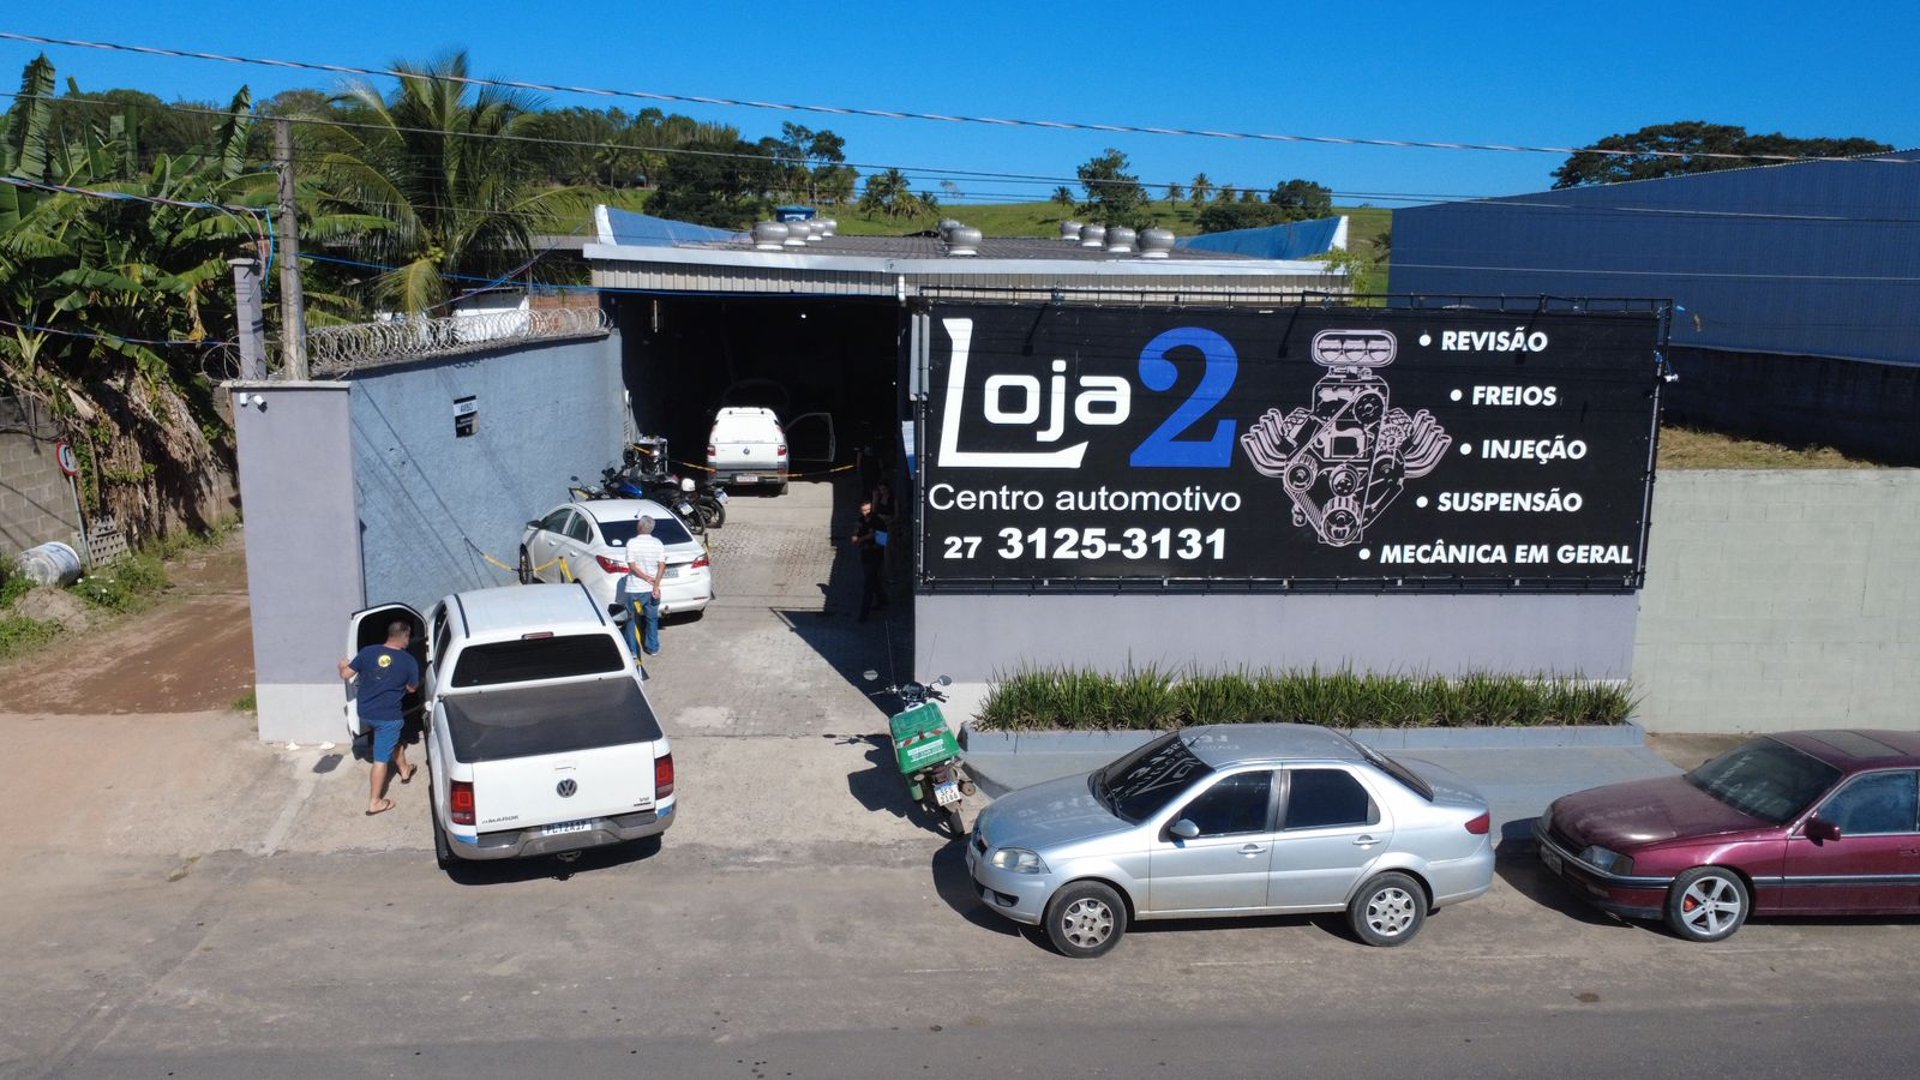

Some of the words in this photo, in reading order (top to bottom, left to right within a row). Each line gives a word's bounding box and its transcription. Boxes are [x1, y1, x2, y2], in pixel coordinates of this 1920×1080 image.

[1441, 326, 1548, 352] REVISÃO
[937, 318, 1131, 469] Loja
[1129, 326, 1239, 468] 2
[1472, 386, 1557, 406] FREIOS
[1482, 435, 1587, 464] INJEÇÃO
[928, 483, 1044, 511] Centro
[1055, 485, 1242, 512] automotivo
[1437, 488, 1583, 512] SUSPENSÃO
[943, 536, 983, 559] 27
[997, 527, 1225, 560] 3125-3131
[1380, 539, 1508, 564] MECÂNICA
[1514, 544, 1549, 564] EM
[1556, 544, 1633, 564] GERAL
